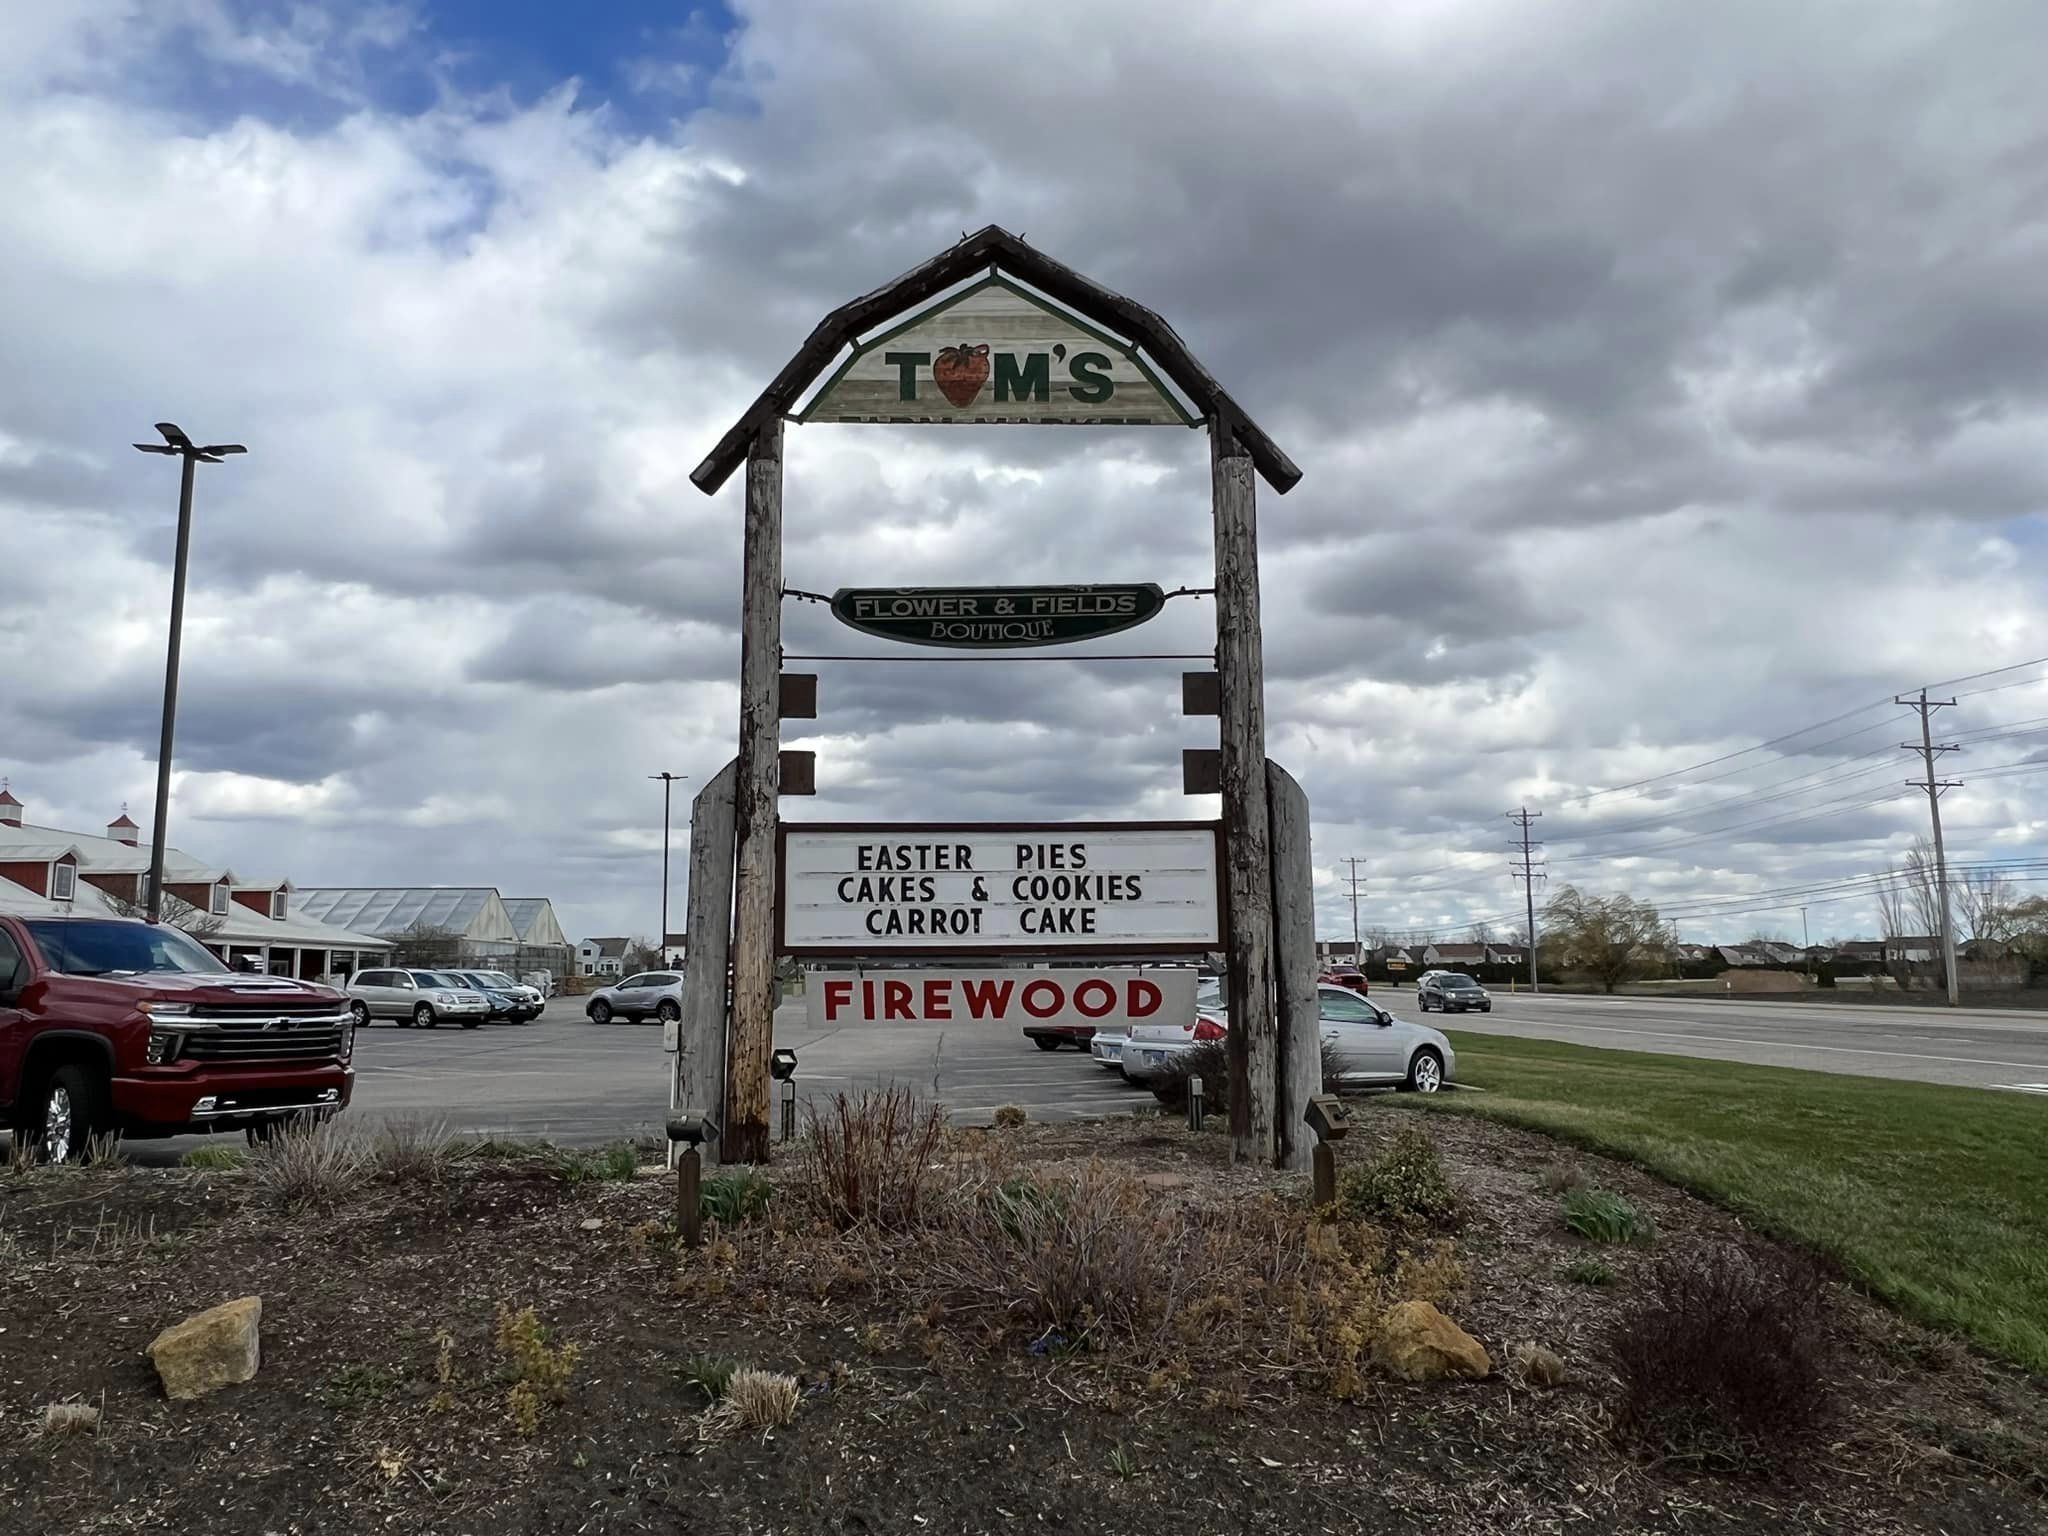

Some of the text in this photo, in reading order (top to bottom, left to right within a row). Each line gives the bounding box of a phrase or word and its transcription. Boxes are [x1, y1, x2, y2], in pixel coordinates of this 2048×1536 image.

[854, 595, 1137, 617] FLOWER & FIELDS
[930, 620, 1055, 641] BOUTIQUE
[857, 844, 1087, 871] EASTER PIES
[837, 875, 1142, 903] CAKES & COOKIES
[865, 907, 1096, 935] CARROT CAKE
[823, 978, 1163, 1021] FIREWOOD
